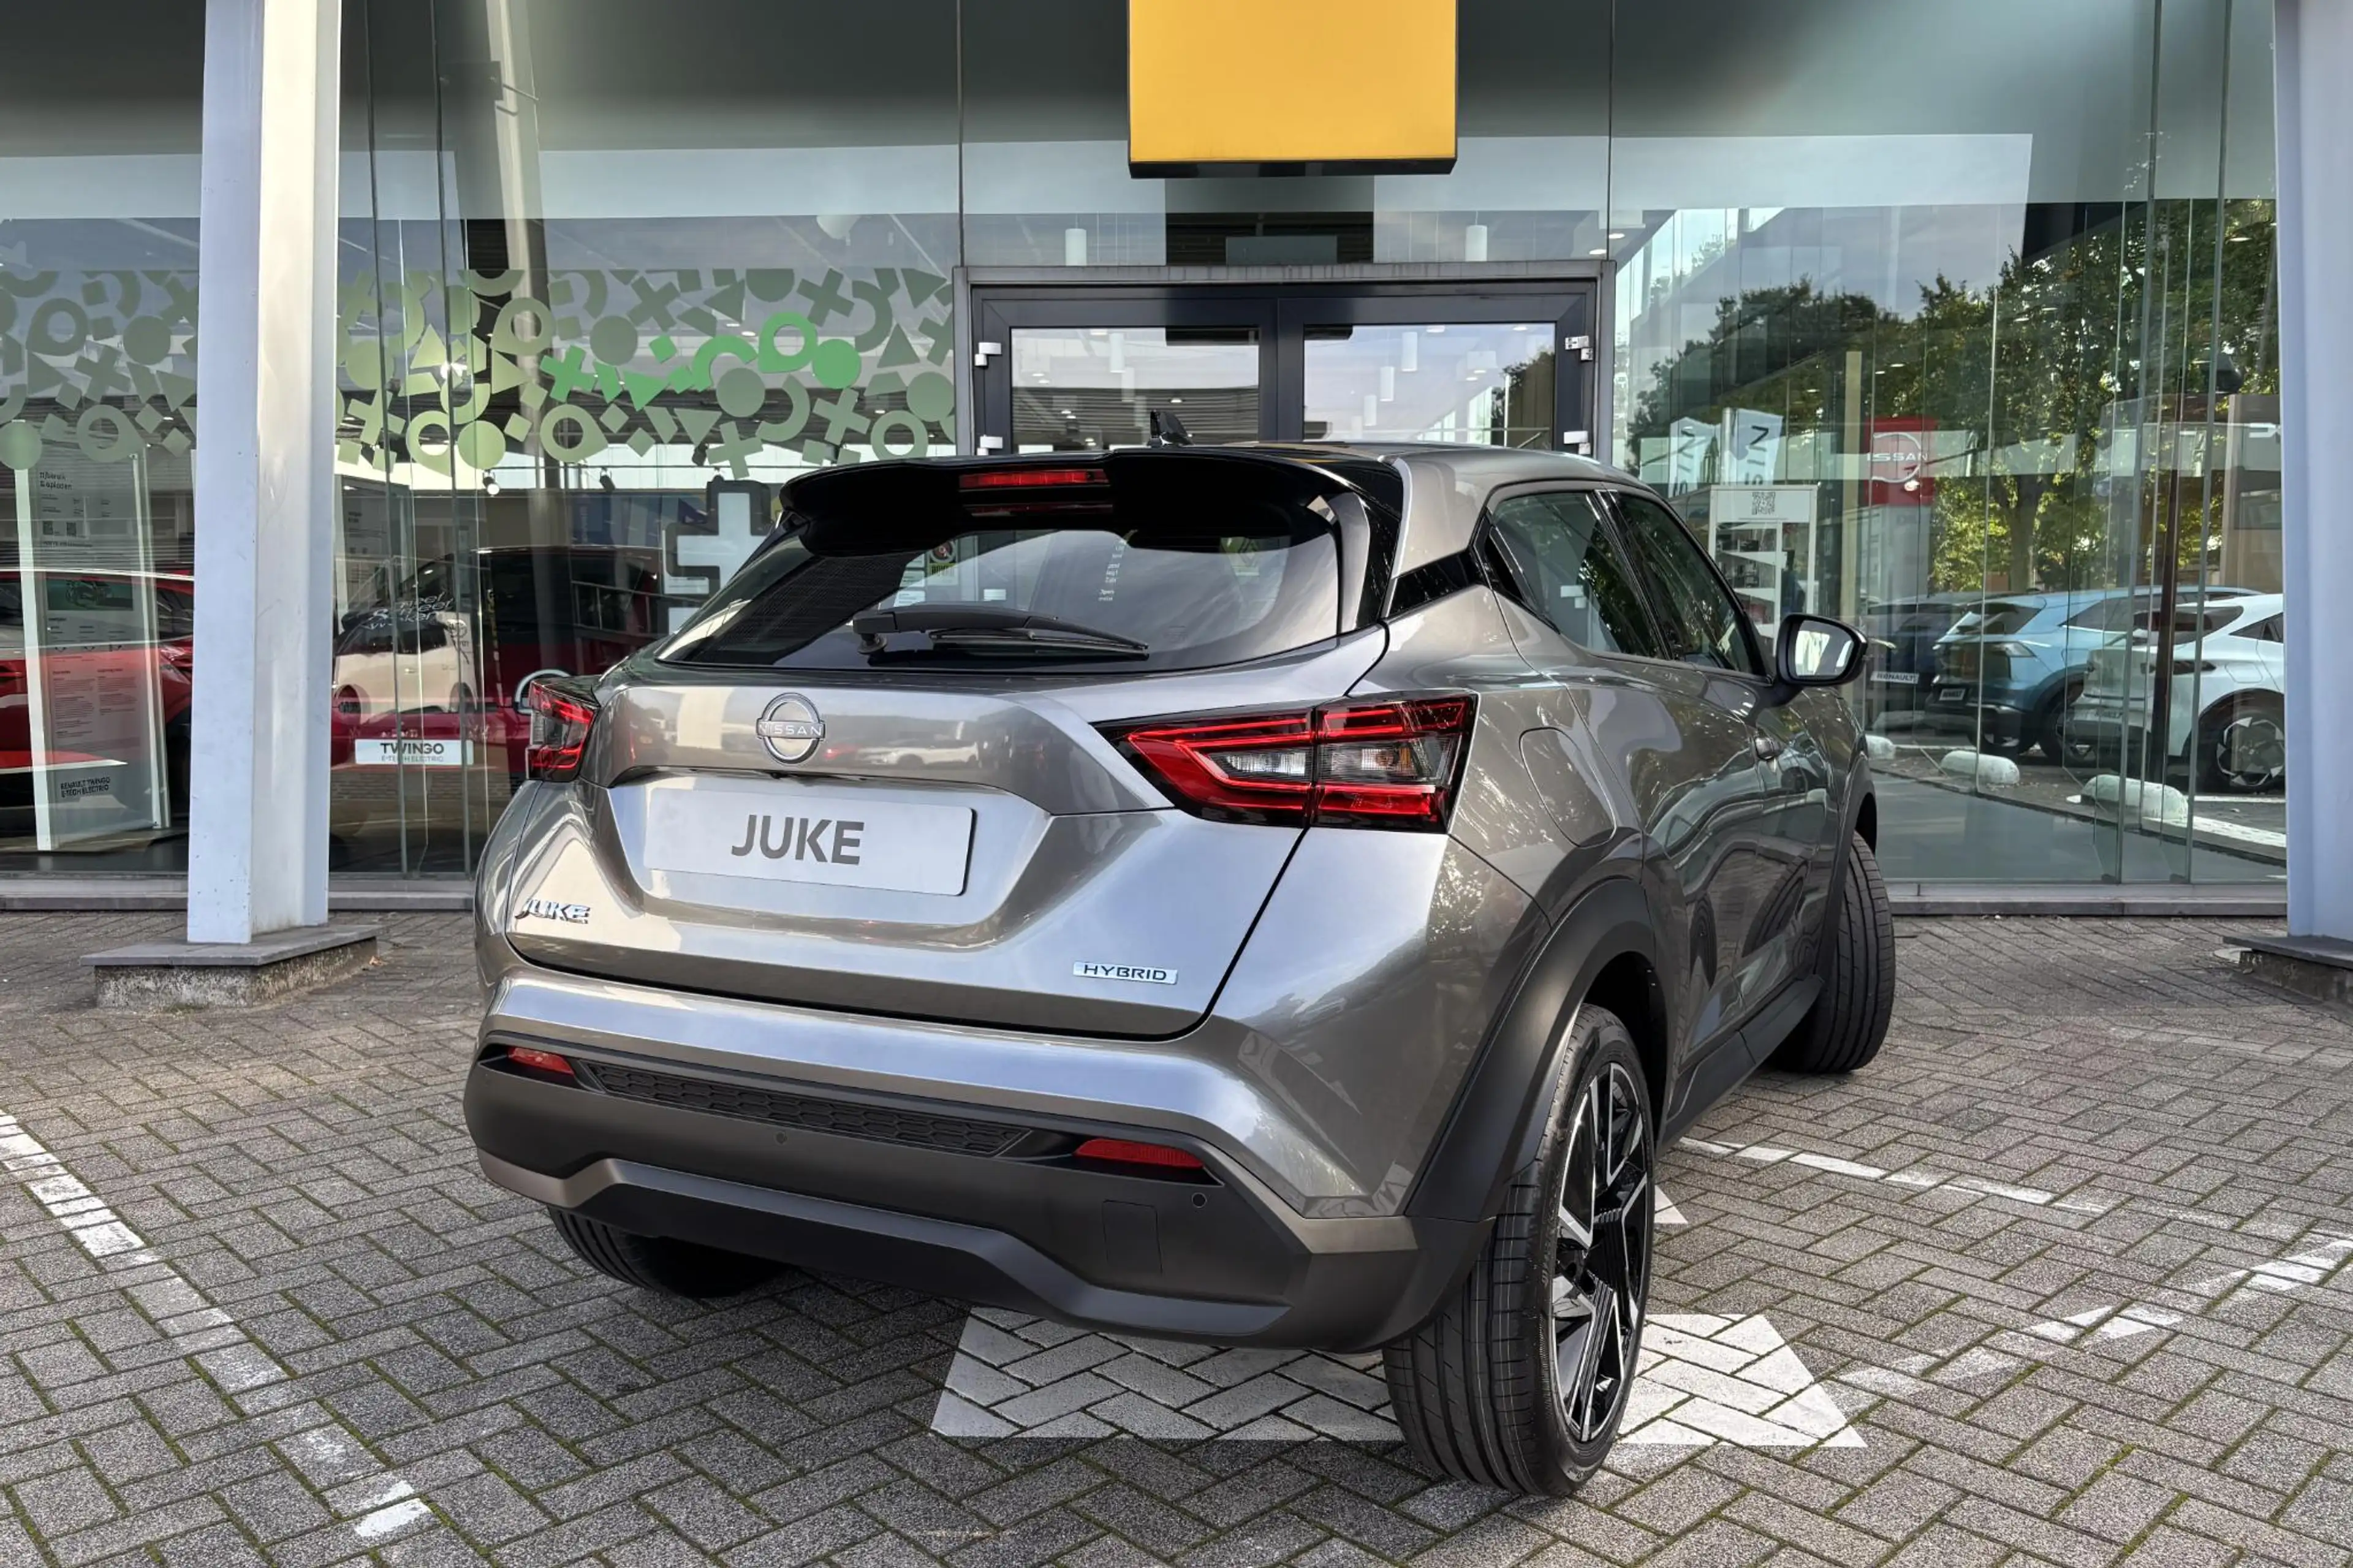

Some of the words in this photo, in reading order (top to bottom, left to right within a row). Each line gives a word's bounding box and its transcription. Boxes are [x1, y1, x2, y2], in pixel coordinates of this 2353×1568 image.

[1866, 452, 1928, 462] ISSAN
[759, 724, 822, 737] NISSAN
[380, 743, 444, 755] TWINGO
[731, 814, 865, 865] JUKE
[515, 899, 591, 924] JUKE
[1083, 964, 1167, 981] HYBRID
